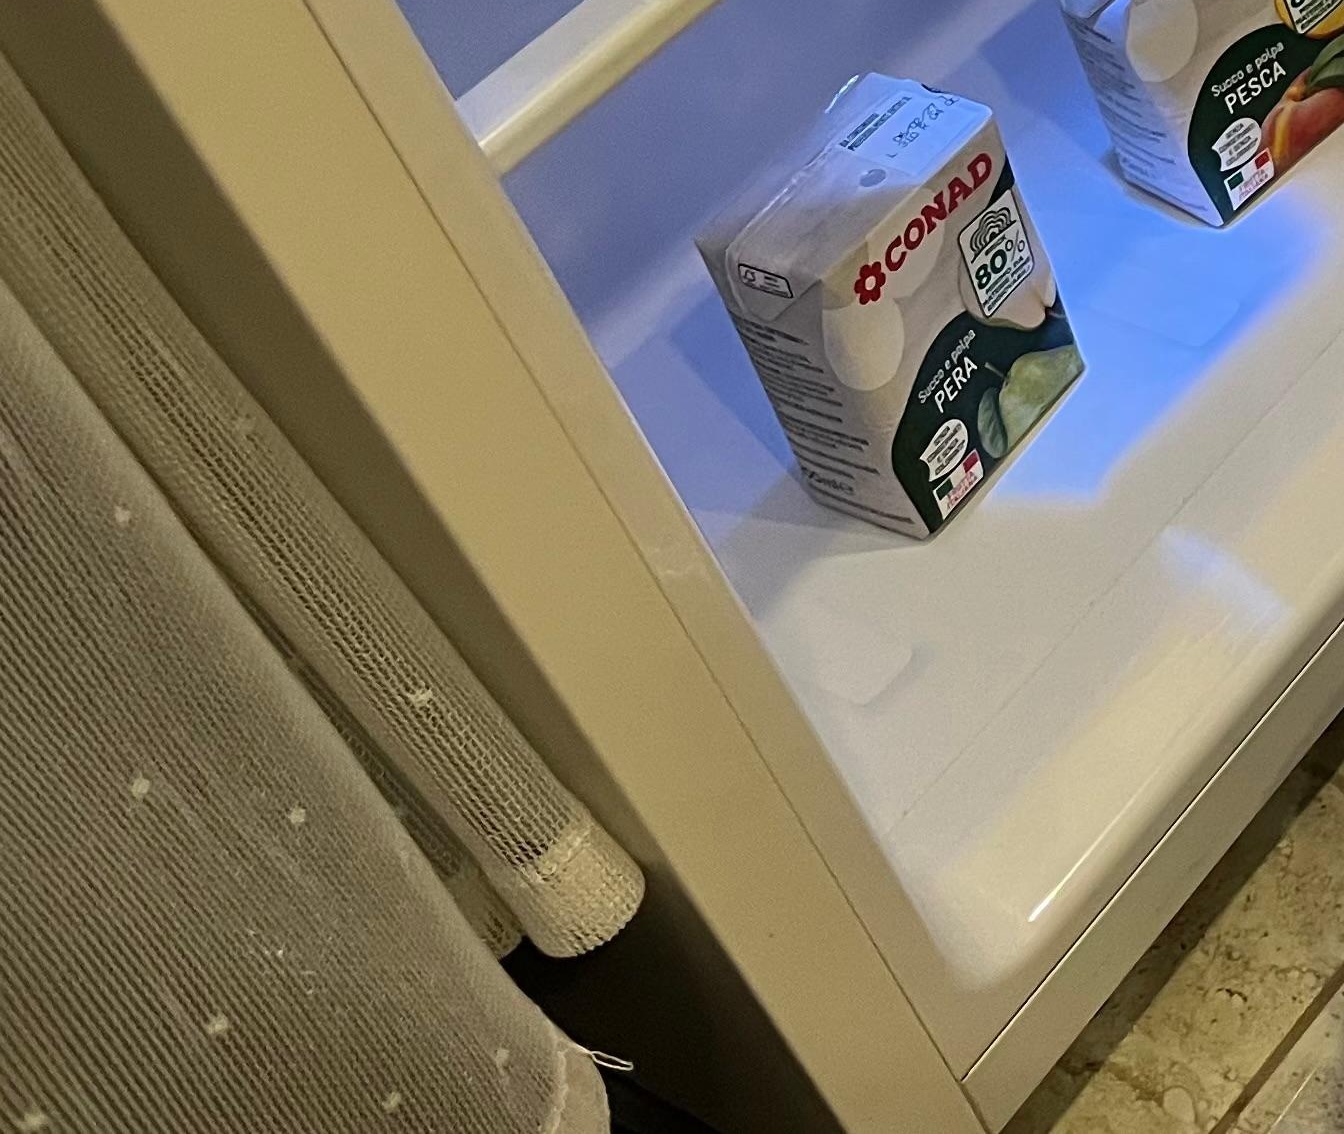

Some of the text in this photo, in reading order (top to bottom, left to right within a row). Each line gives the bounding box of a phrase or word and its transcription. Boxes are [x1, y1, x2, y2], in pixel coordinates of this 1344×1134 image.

[1211, 41, 1285, 97] Succo e polpa
[1224, 60, 1287, 115] PESCA
[884, 152, 993, 273] CONAD
[974, 234, 1027, 289] 80%
[918, 368, 945, 404] Succo
[950, 329, 976, 364] polpa
[934, 356, 978, 414] PERA
